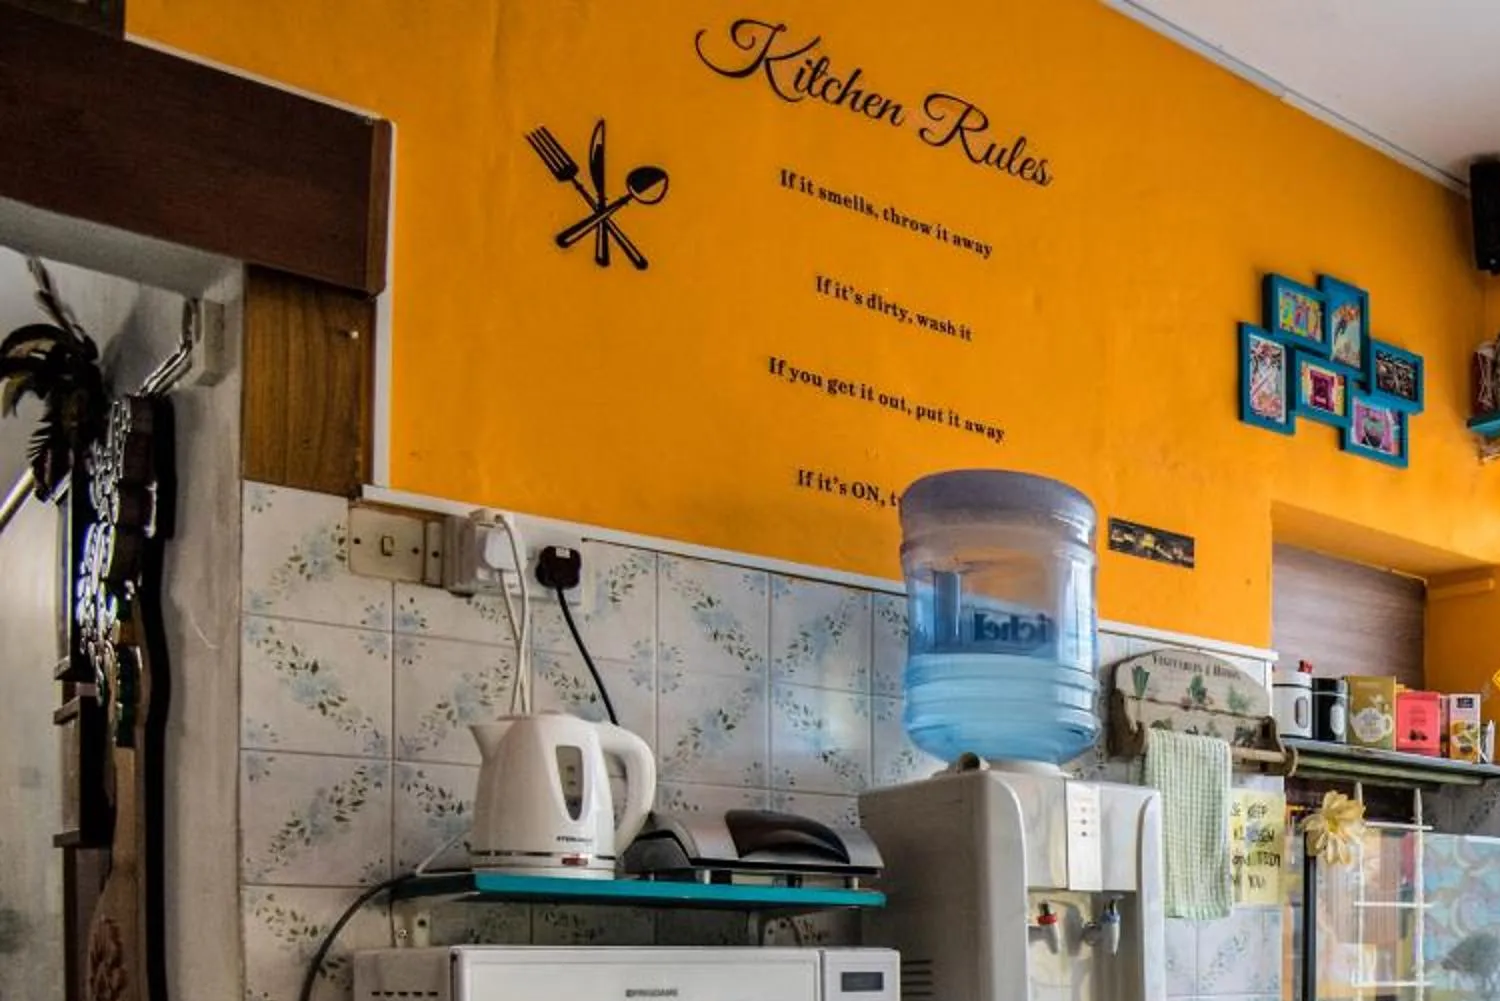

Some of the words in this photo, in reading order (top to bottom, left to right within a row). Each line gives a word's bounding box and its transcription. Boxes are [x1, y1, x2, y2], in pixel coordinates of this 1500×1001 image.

[694, 18, 905, 128] Kitchen
[919, 92, 1053, 188] Rules
[779, 168, 798, 188] If
[799, 176, 815, 196] it
[818, 187, 879, 219] smells,
[883, 207, 933, 236] throw
[936, 223, 949, 243] it
[952, 234, 993, 260] away
[815, 275, 832, 295] If
[834, 282, 864, 306] it's
[866, 294, 914, 324] dirty,
[916, 313, 957, 337] wash
[959, 324, 973, 342] it
[768, 356, 787, 377] If
[789, 367, 823, 387] you
[827, 377, 857, 396] get
[860, 383, 874, 401] it
[878, 392, 912, 416] out,
[915, 404, 944, 423] put
[948, 410, 961, 428] it
[964, 420, 1006, 444] away
[798, 469, 815, 488] If
[817, 473, 848, 496] it's
[851, 482, 886, 507] ON,
